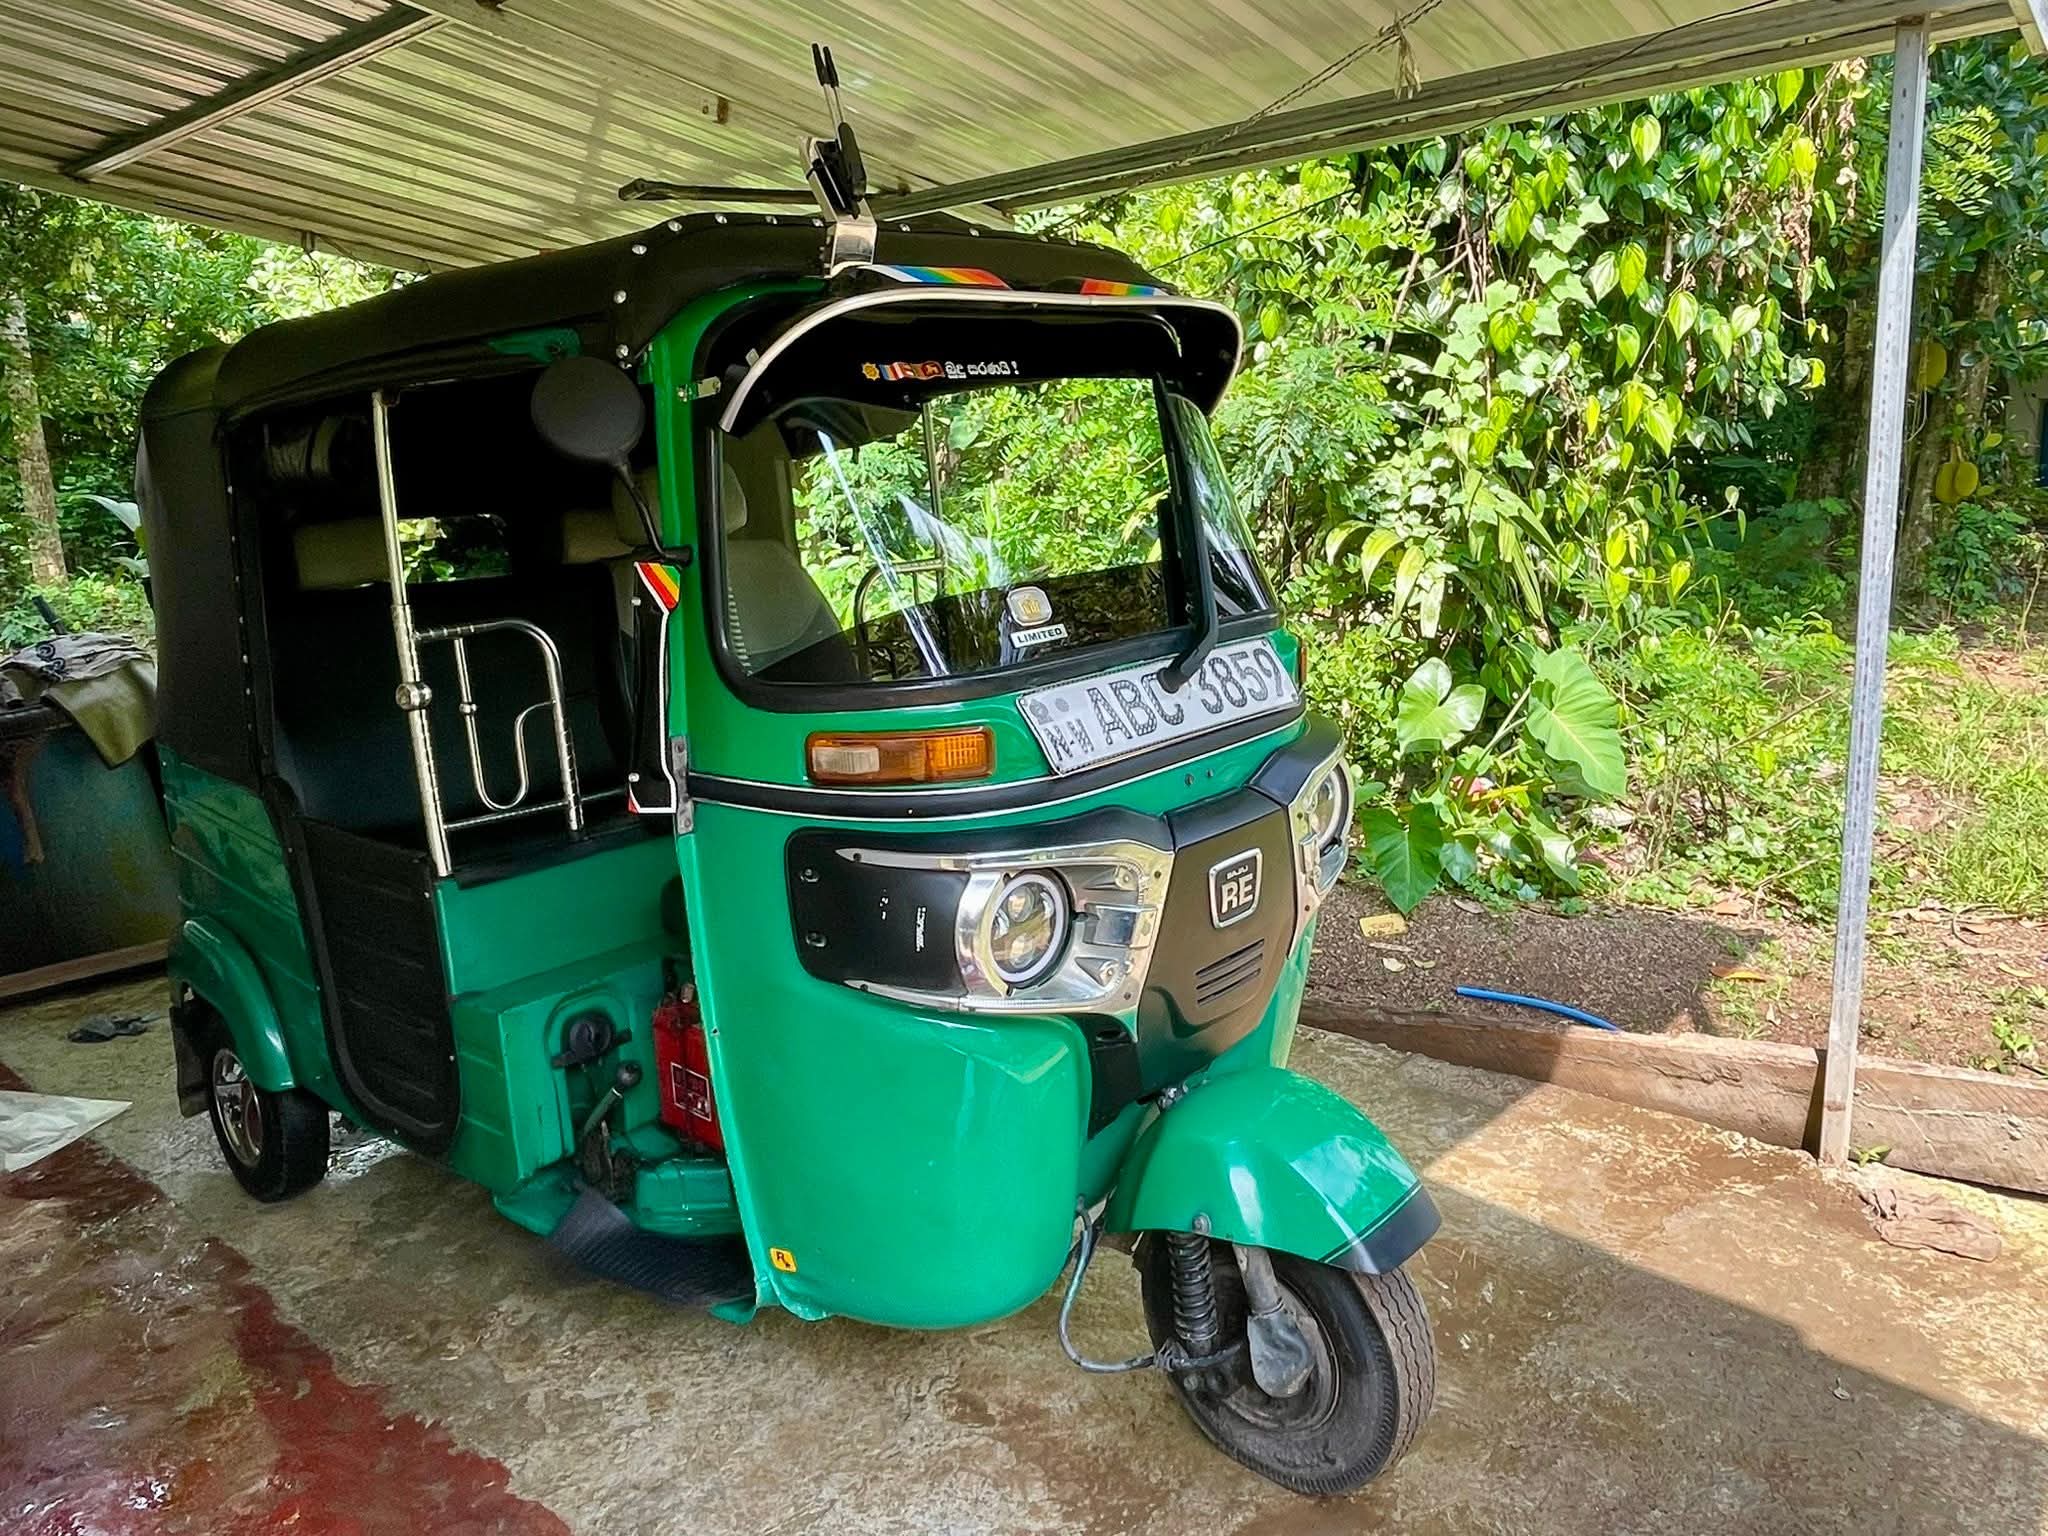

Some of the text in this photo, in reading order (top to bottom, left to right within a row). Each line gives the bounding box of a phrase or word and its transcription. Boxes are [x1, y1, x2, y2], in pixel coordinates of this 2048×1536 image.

[1017, 627, 1062, 643] LIMITED
[1086, 648, 1284, 745] ABC 3859
[1221, 873, 1254, 914] RE
